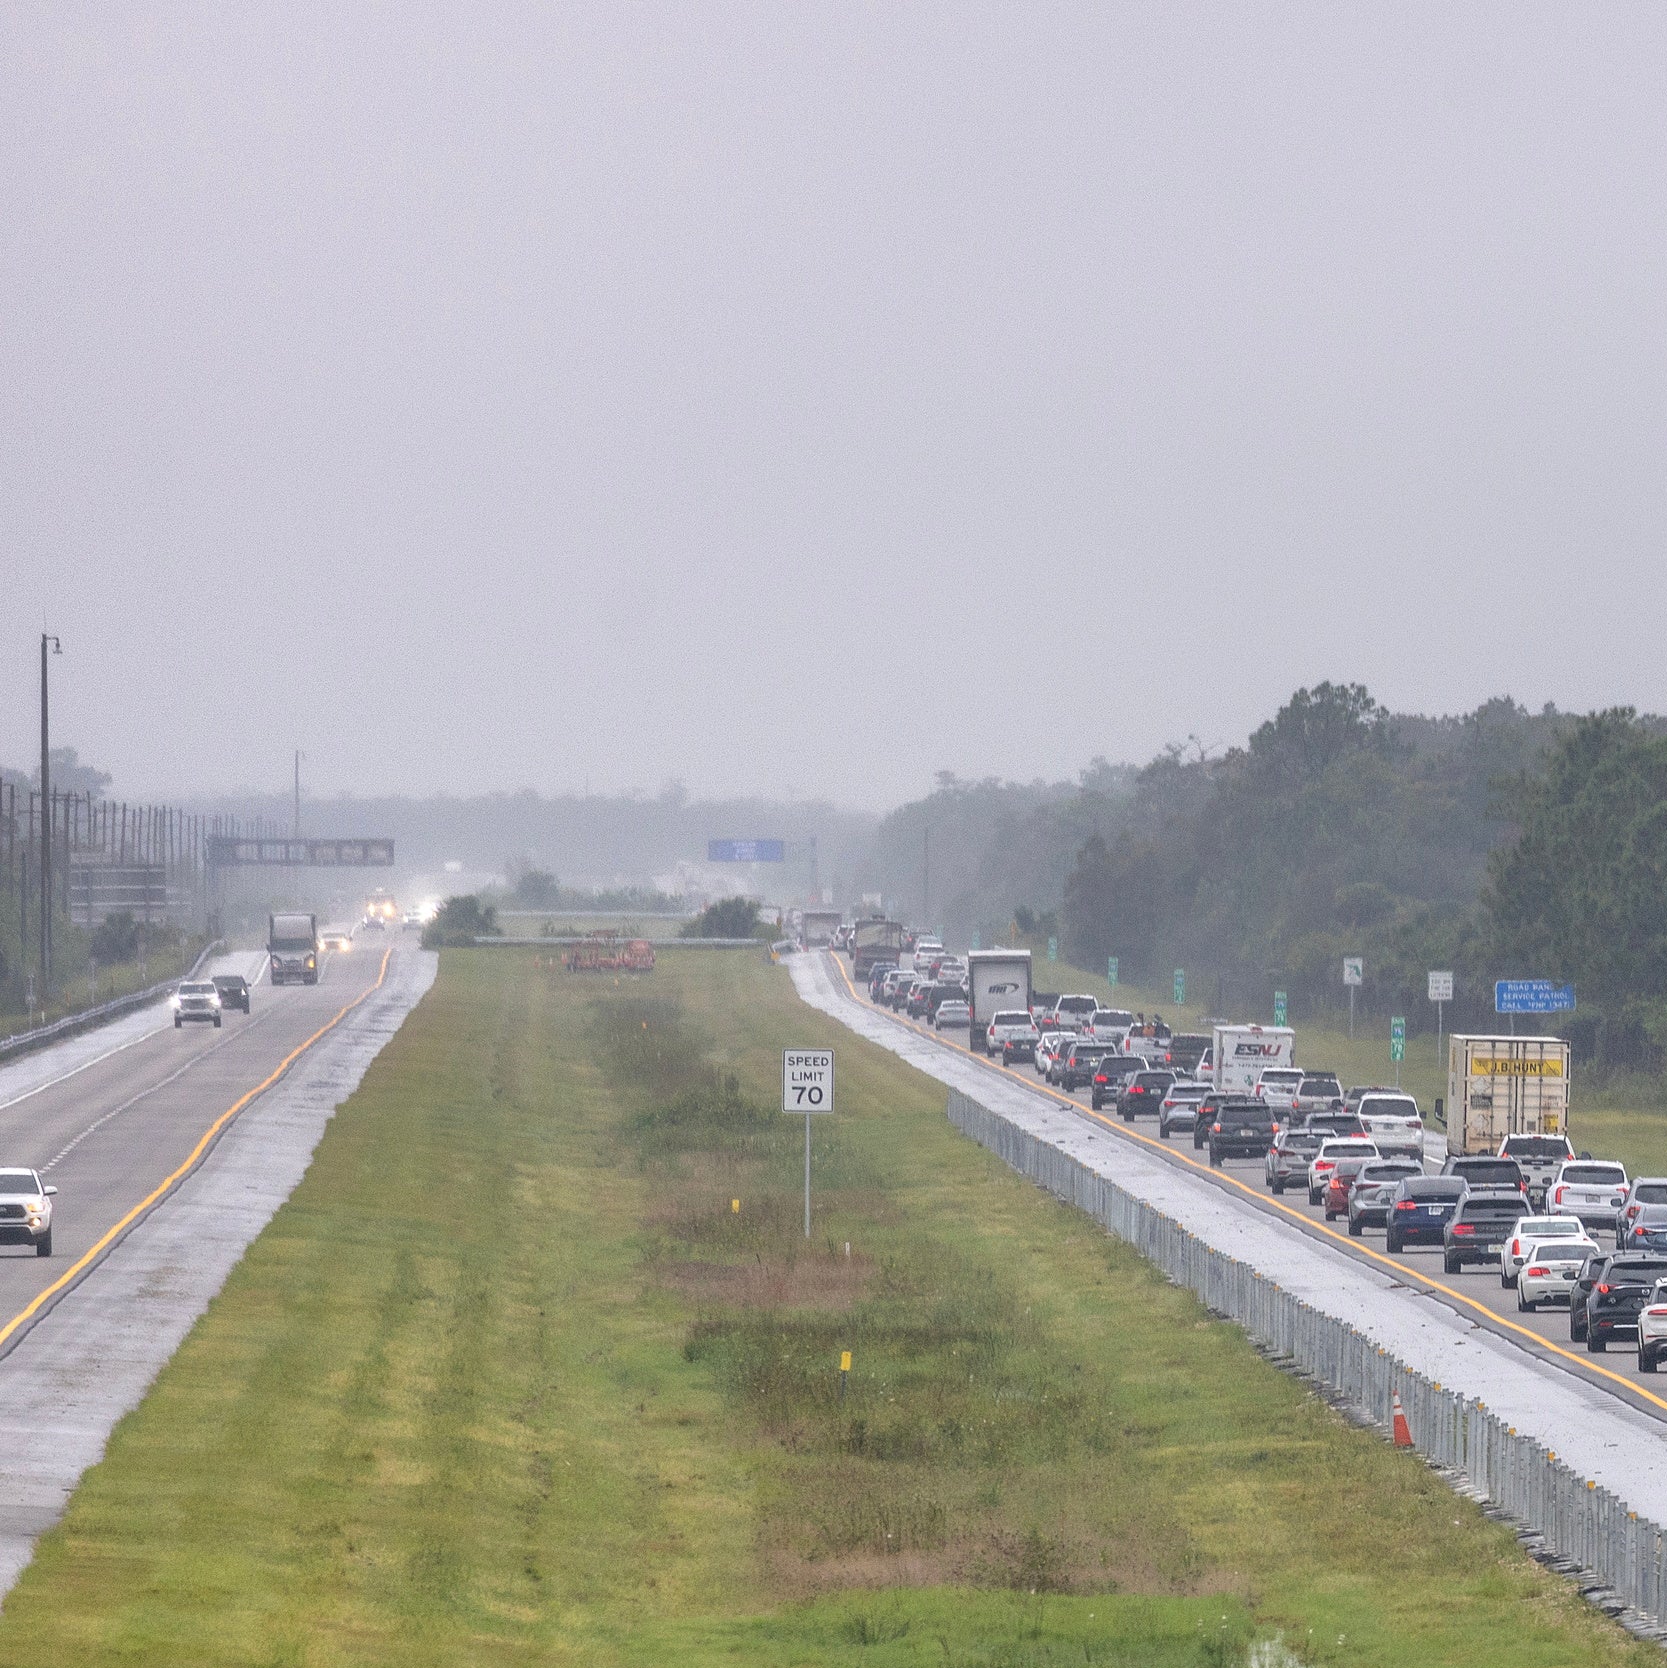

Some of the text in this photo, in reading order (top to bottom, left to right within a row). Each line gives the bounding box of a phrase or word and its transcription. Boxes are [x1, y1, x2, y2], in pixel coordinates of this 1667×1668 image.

[1539, 992, 1569, 1000] PATROL
[788, 1056, 830, 1067] SPEED
[1513, 1063, 1544, 1073] HUNT
[792, 1071, 825, 1081] LIMIT
[792, 1086, 823, 1104] 70
